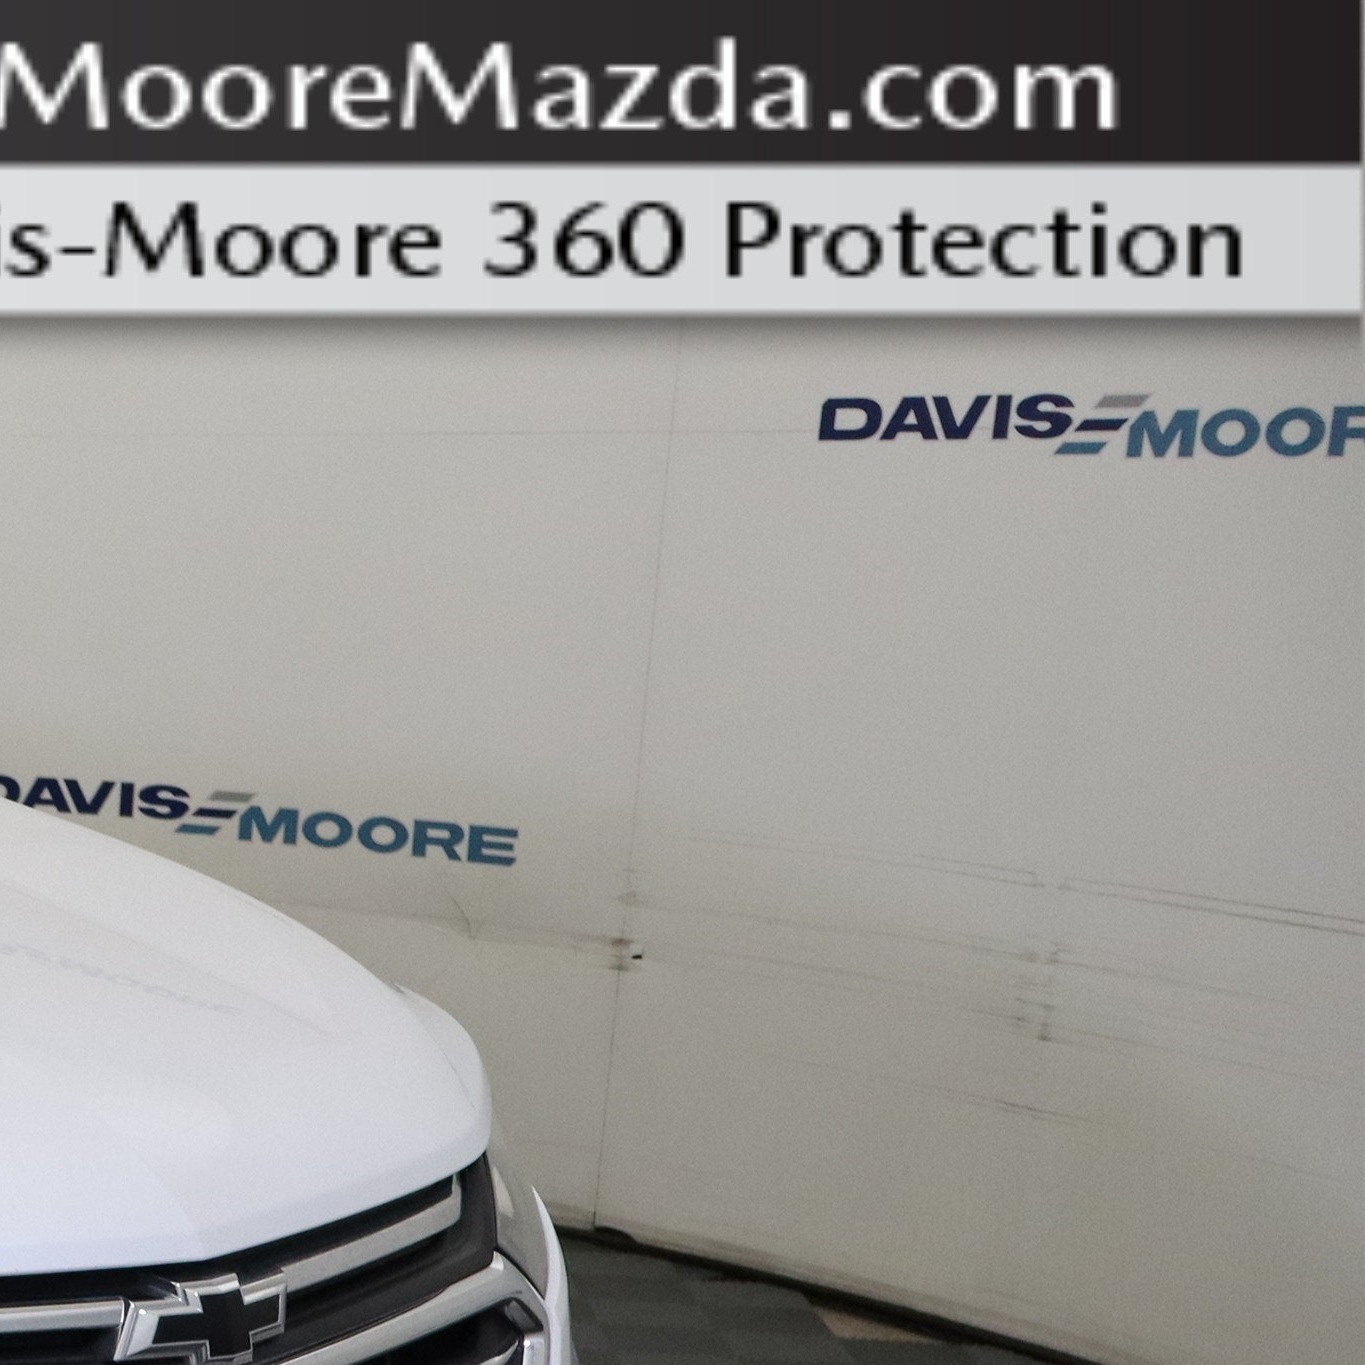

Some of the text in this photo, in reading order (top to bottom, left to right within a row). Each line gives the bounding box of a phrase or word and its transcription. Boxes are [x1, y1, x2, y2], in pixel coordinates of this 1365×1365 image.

[818, 393, 1365, 458] DAVIS MOOR
[238, 805, 518, 867] MOORE
